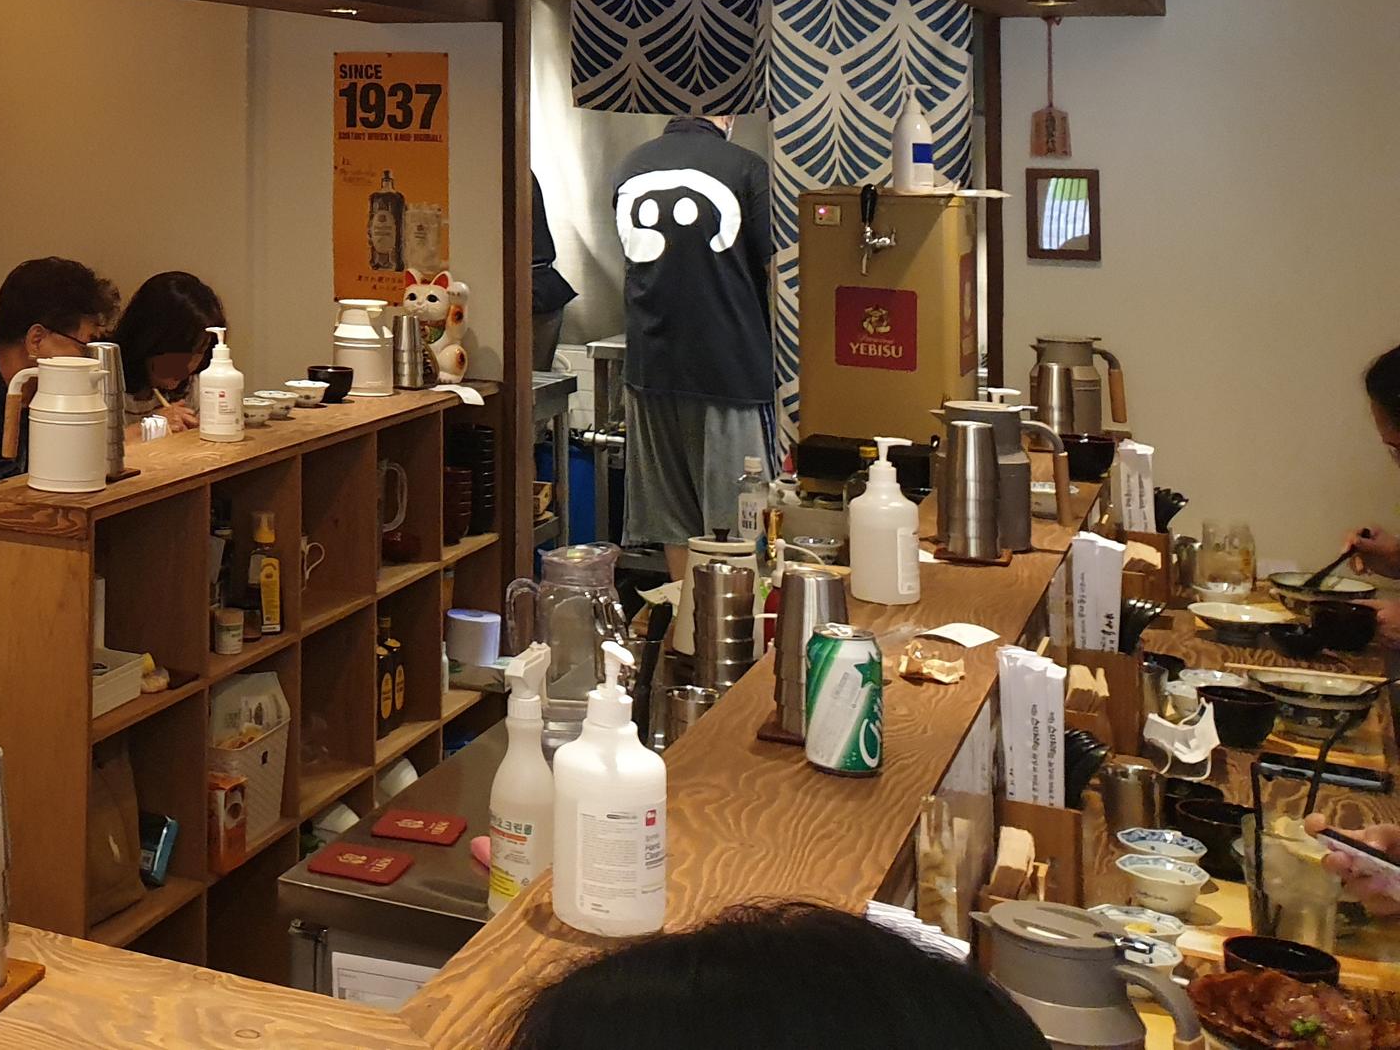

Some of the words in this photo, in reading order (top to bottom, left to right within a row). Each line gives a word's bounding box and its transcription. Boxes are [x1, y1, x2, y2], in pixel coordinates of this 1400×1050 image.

[339, 64, 382, 79] SINCE
[338, 82, 442, 130] 1937
[849, 341, 903, 358] YEBISU
